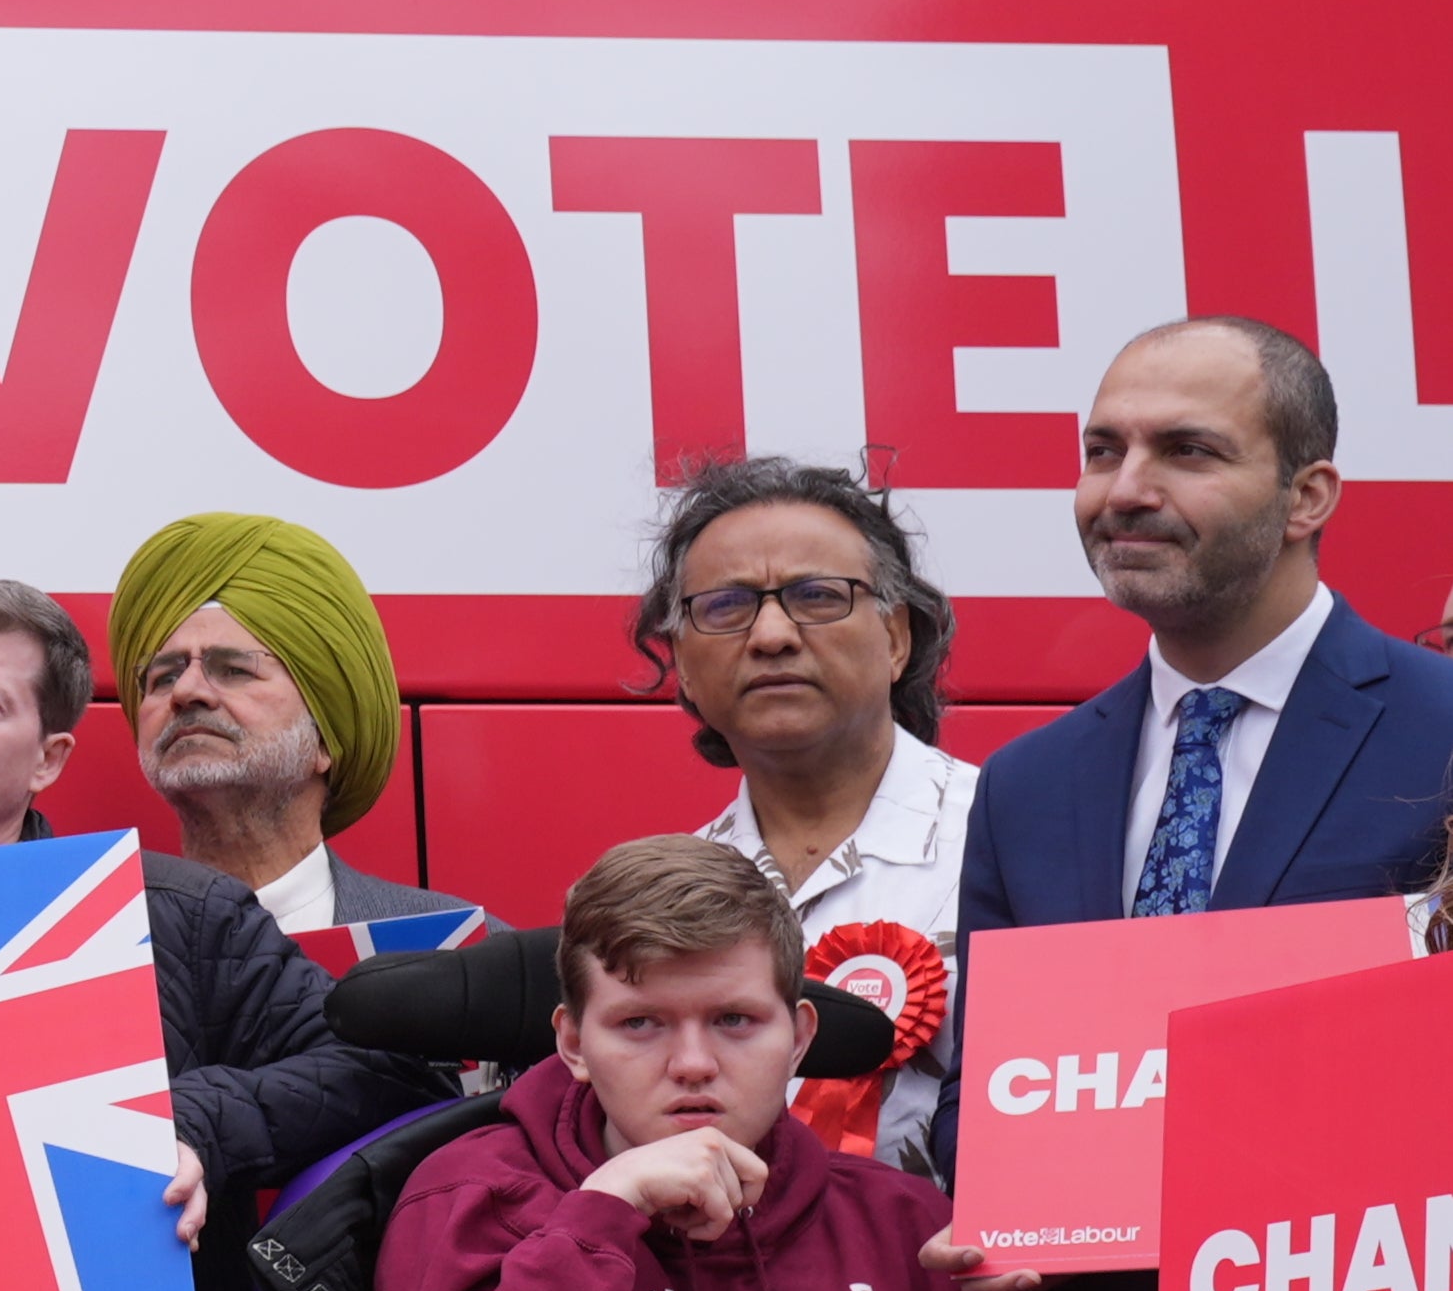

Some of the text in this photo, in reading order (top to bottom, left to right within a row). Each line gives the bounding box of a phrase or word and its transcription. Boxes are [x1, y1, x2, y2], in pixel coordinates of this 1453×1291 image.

[988, 1049, 1165, 1115] CHA
[981, 1226, 1140, 1248] Vote Labour
